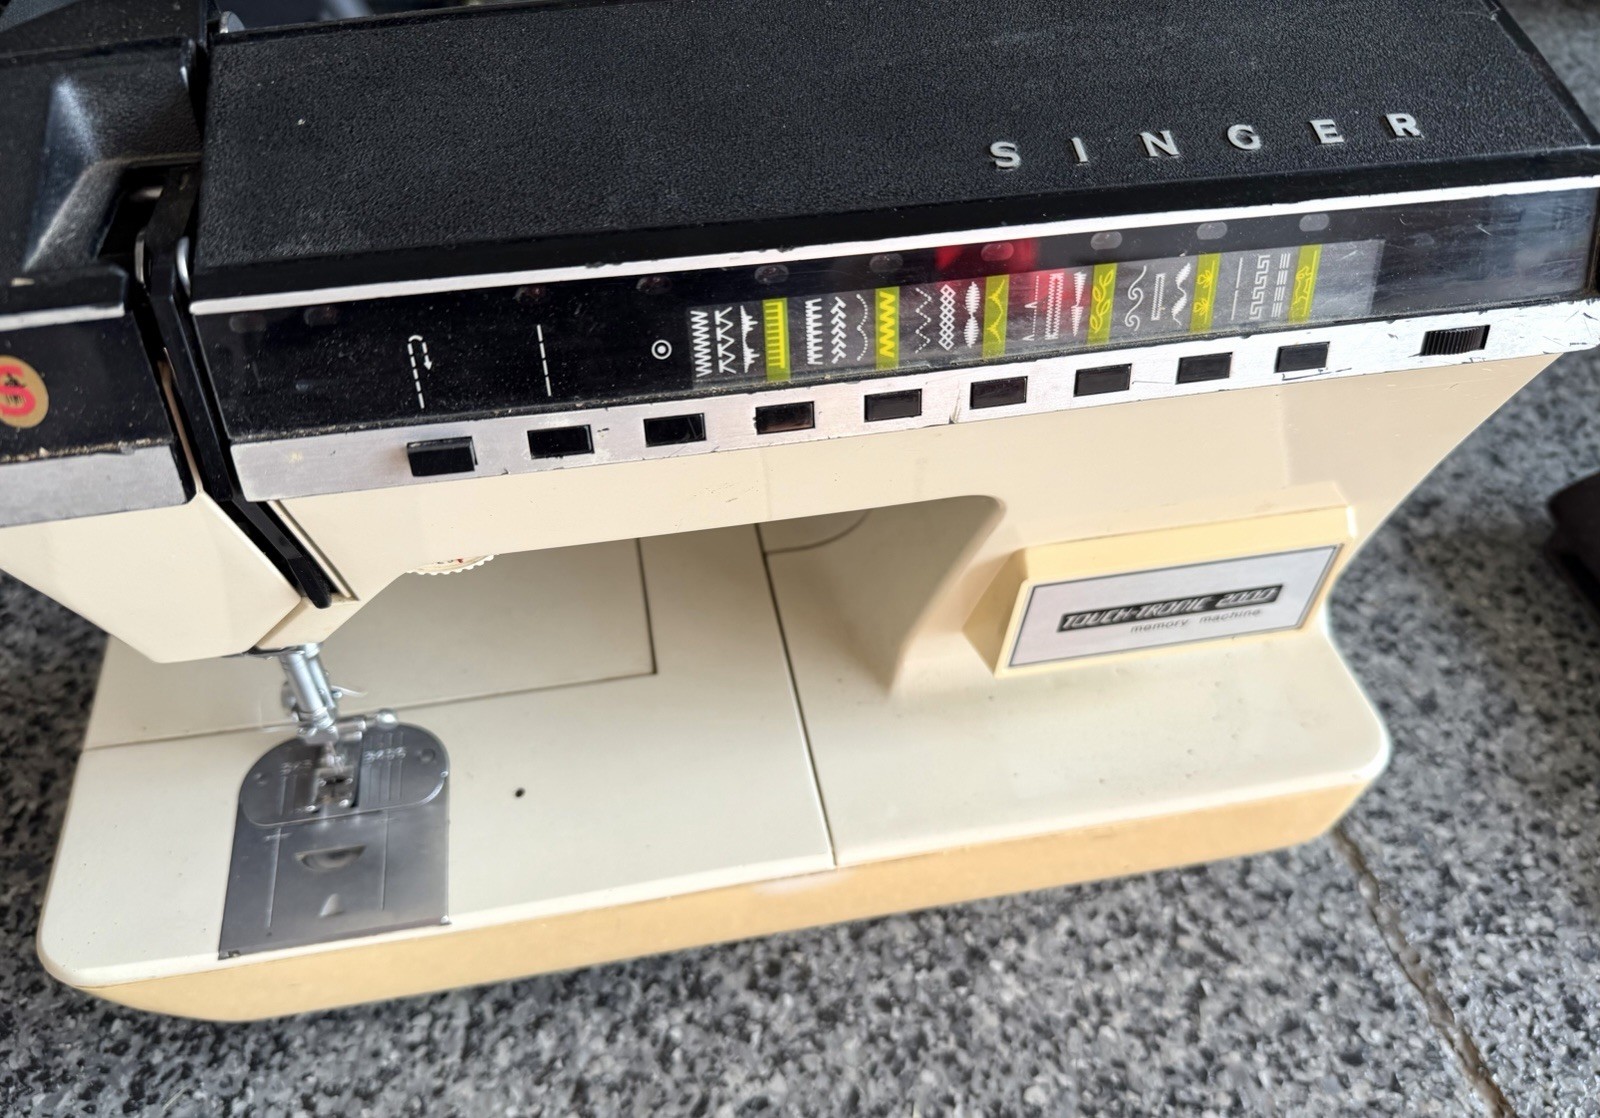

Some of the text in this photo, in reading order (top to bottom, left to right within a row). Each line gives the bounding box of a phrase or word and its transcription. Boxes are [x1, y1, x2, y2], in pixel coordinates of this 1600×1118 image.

[989, 112, 1424, 169] SINGER
[1062, 587, 1277, 629] TOUCH-TRONIC 2000
[1130, 609, 1261, 633] memory machine
